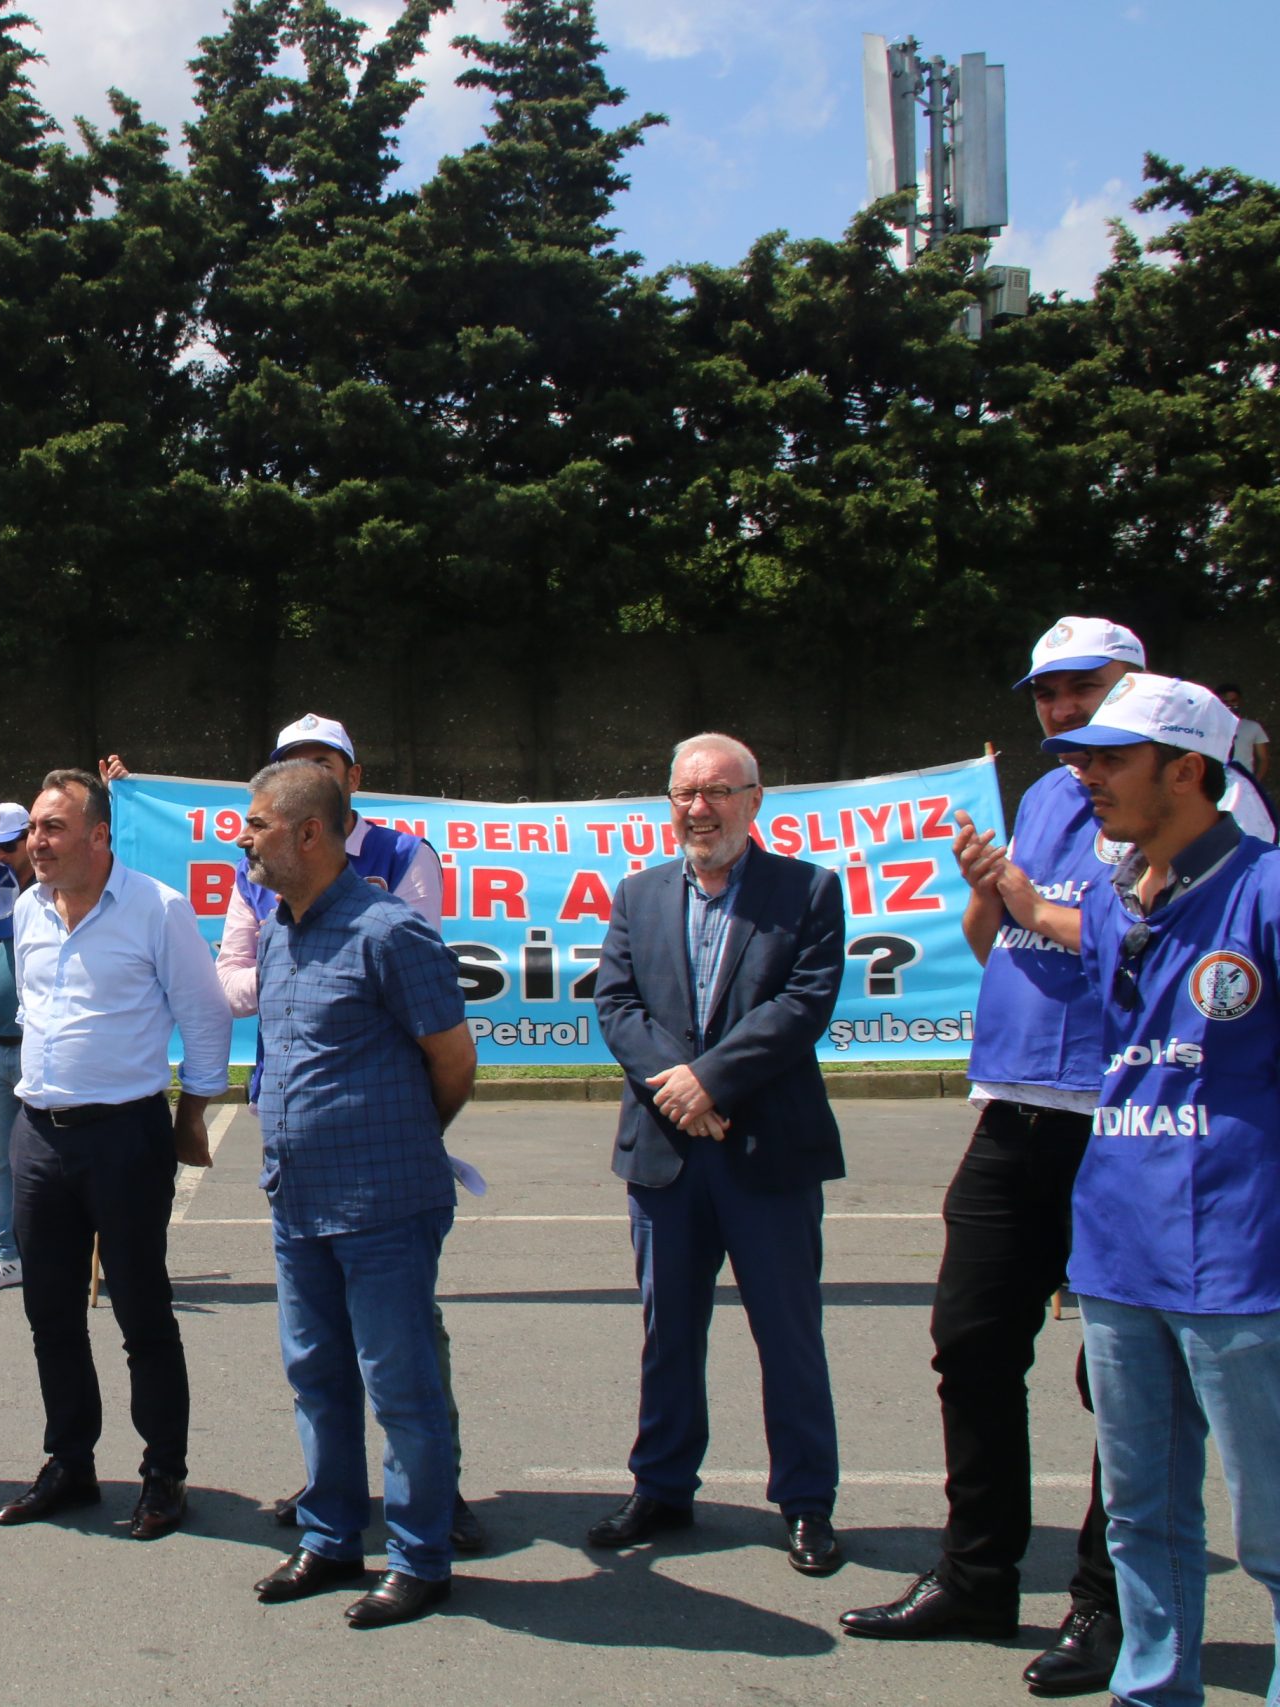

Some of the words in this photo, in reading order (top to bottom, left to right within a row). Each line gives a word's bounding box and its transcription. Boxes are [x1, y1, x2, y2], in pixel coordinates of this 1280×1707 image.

[447, 815, 569, 853] BERİ
[470, 1016, 590, 1046] Petrol
[827, 1010, 975, 1051] şubesi
